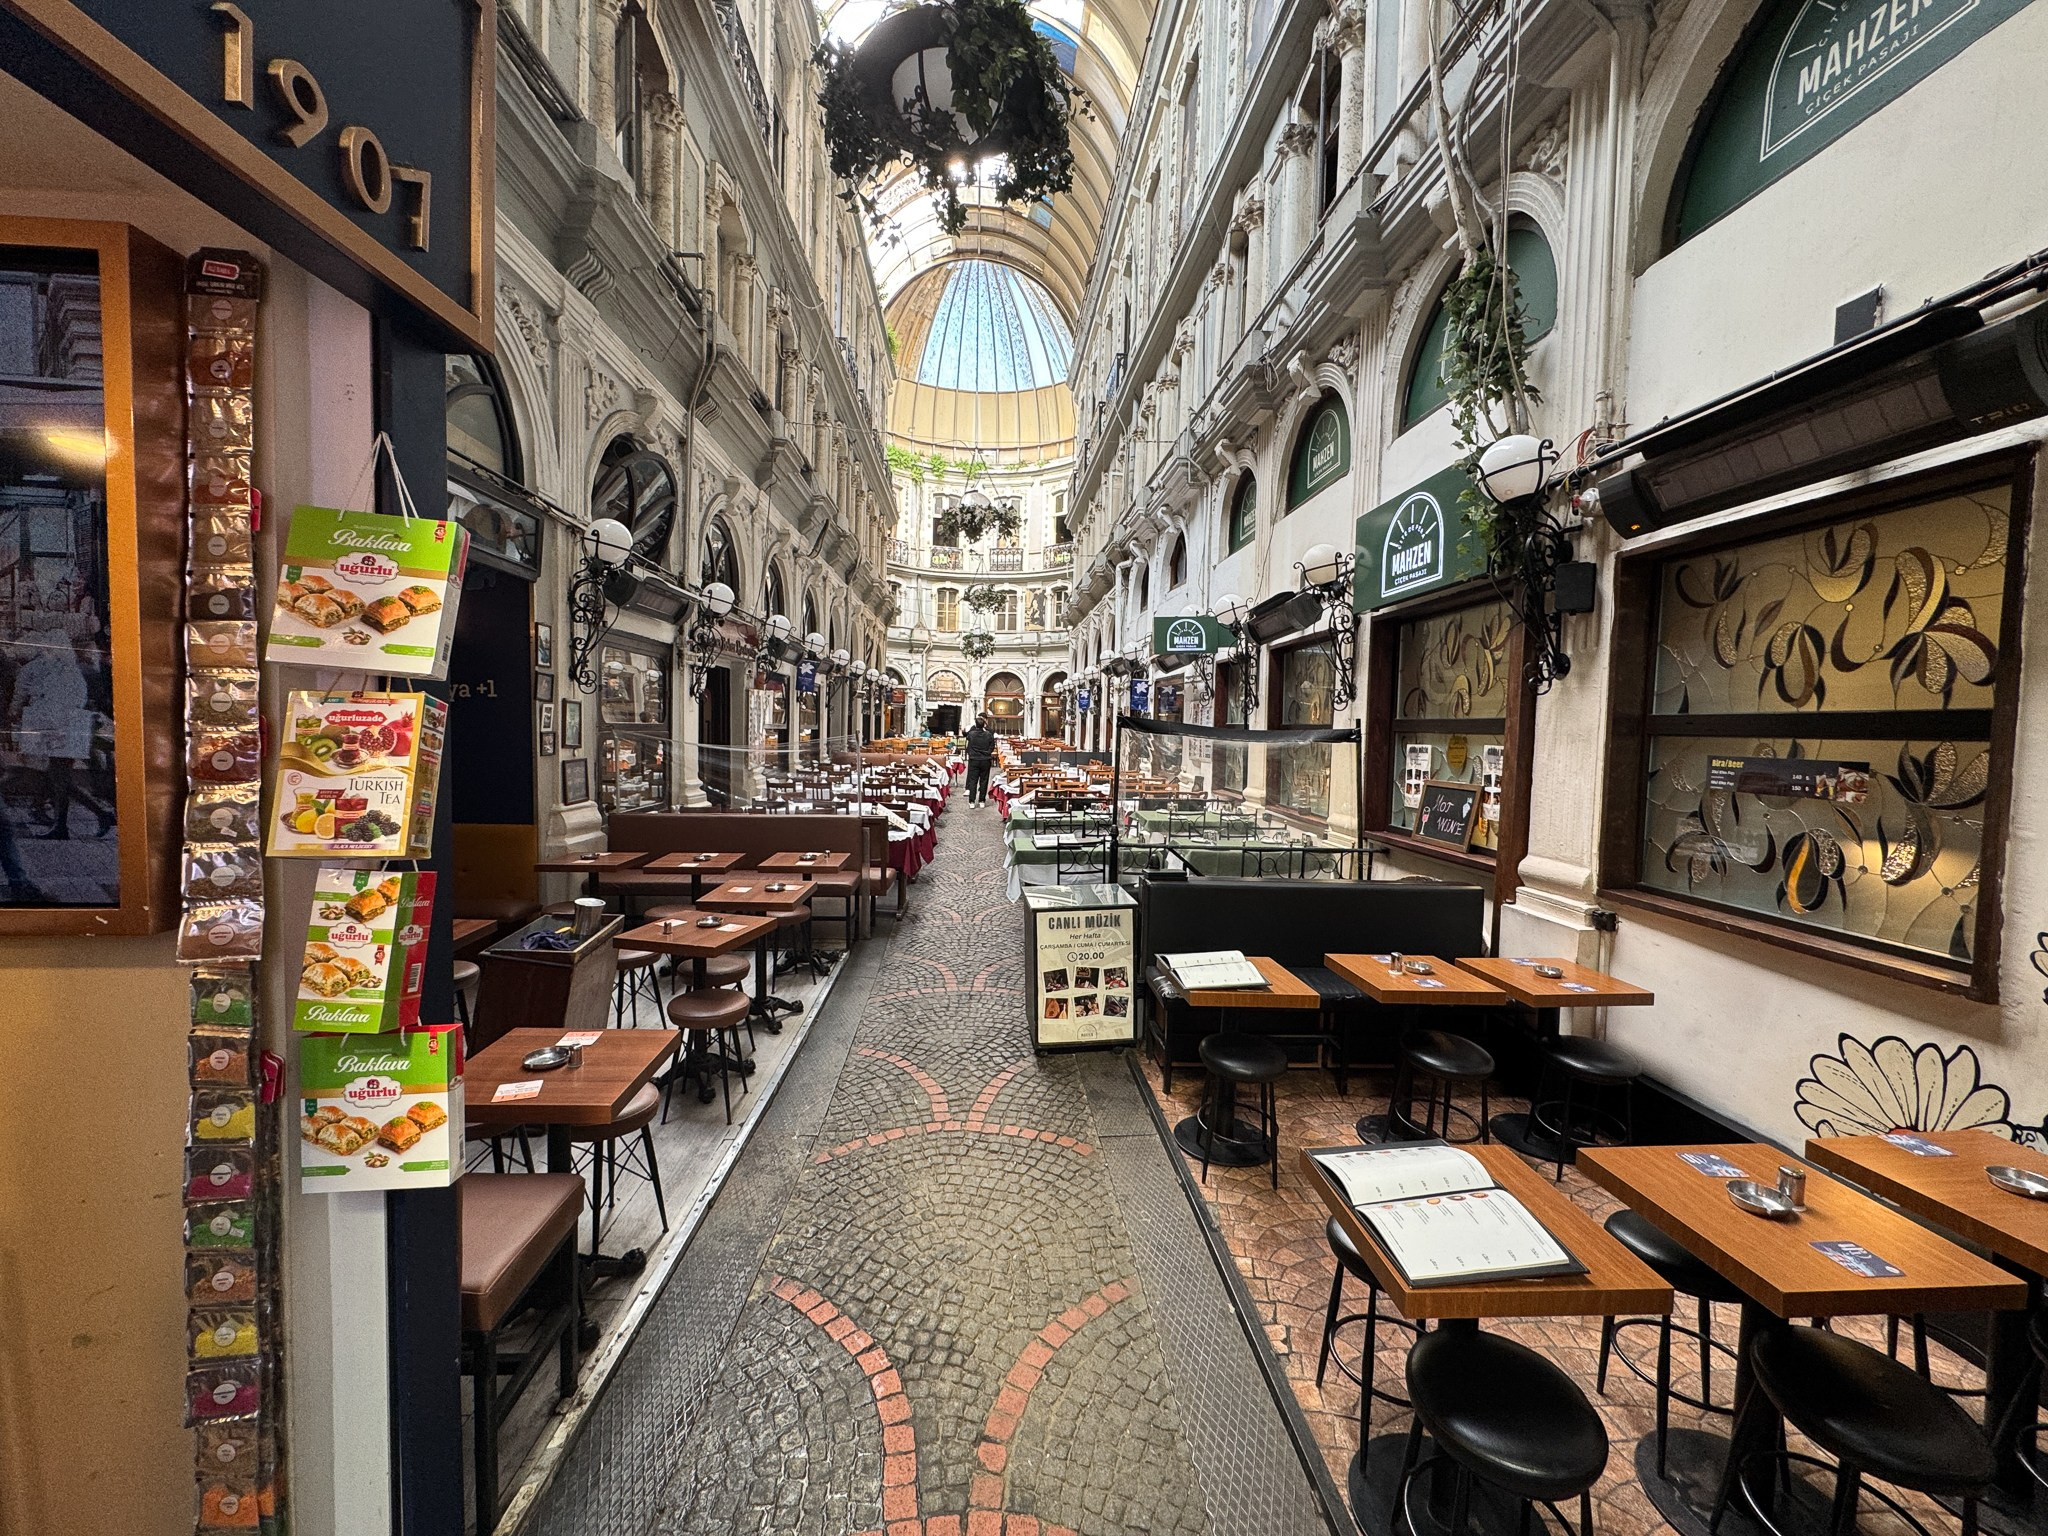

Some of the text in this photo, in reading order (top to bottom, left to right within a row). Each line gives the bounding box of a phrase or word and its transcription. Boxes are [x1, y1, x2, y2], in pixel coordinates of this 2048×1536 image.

[1858, 24, 1919, 76] PASAJI
[210, 2, 431, 253] 1907
[1312, 441, 1335, 472] MAHZEN
[328, 528, 412, 552] Baklava
[1391, 540, 1432, 576] MAHZEN
[339, 562, 393, 576] uğurlu
[1173, 636, 1199, 645] MAHZEN
[328, 713, 384, 723] uğurluzade
[349, 777, 404, 791] TURKISH
[379, 791, 401, 805] TEA
[1432, 794, 1455, 813] HOT
[1048, 912, 1121, 930] CANLI MÜZİK
[330, 931, 369, 942] uğurlu
[1039, 943, 1073, 951] ÇARŞAMBA
[1078, 951, 1105, 961] 20.00
[303, 1005, 371, 1023] Baklava
[334, 1053, 411, 1074] Baklava
[348, 1088, 398, 1100] uğurlu
